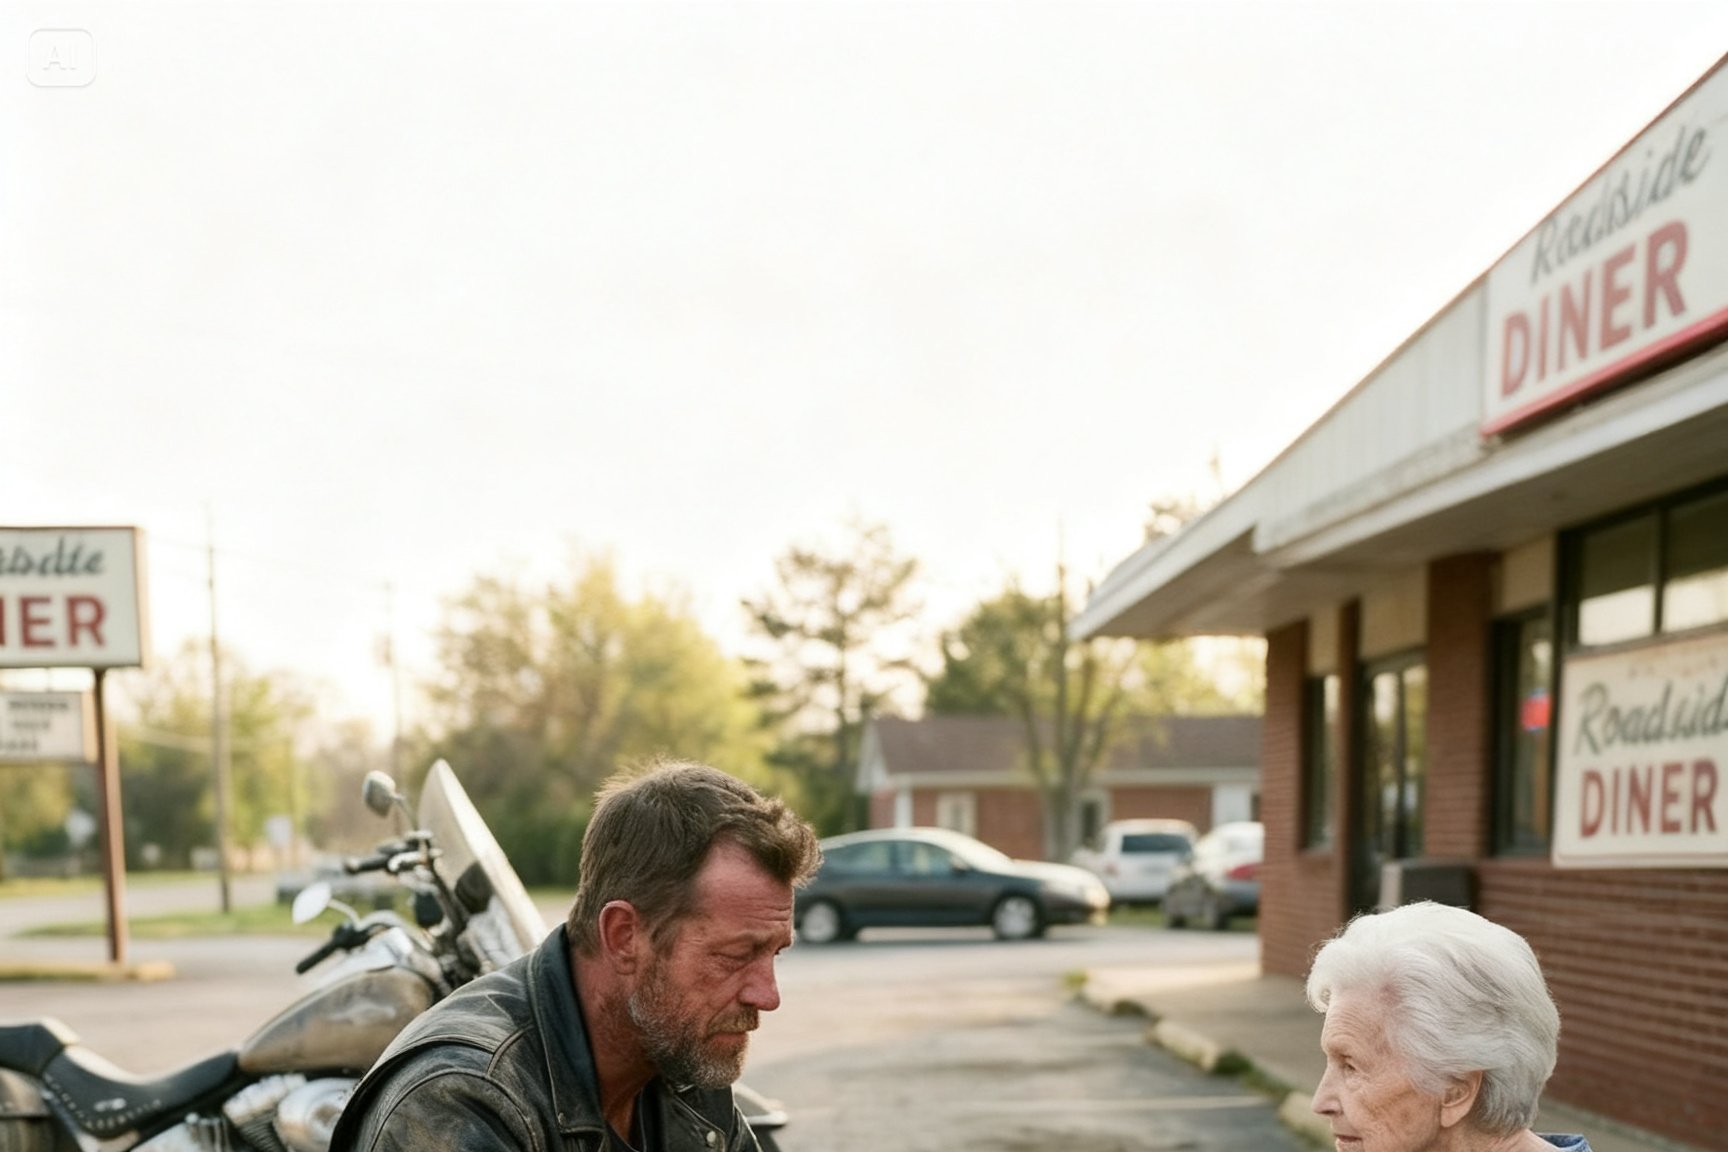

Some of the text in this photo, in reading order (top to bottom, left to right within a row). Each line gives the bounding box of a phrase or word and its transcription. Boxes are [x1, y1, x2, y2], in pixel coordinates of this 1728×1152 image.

[1502, 220, 1689, 397] DINER
[0, 596, 106, 647] ER
[1580, 758, 1718, 838] DINER
